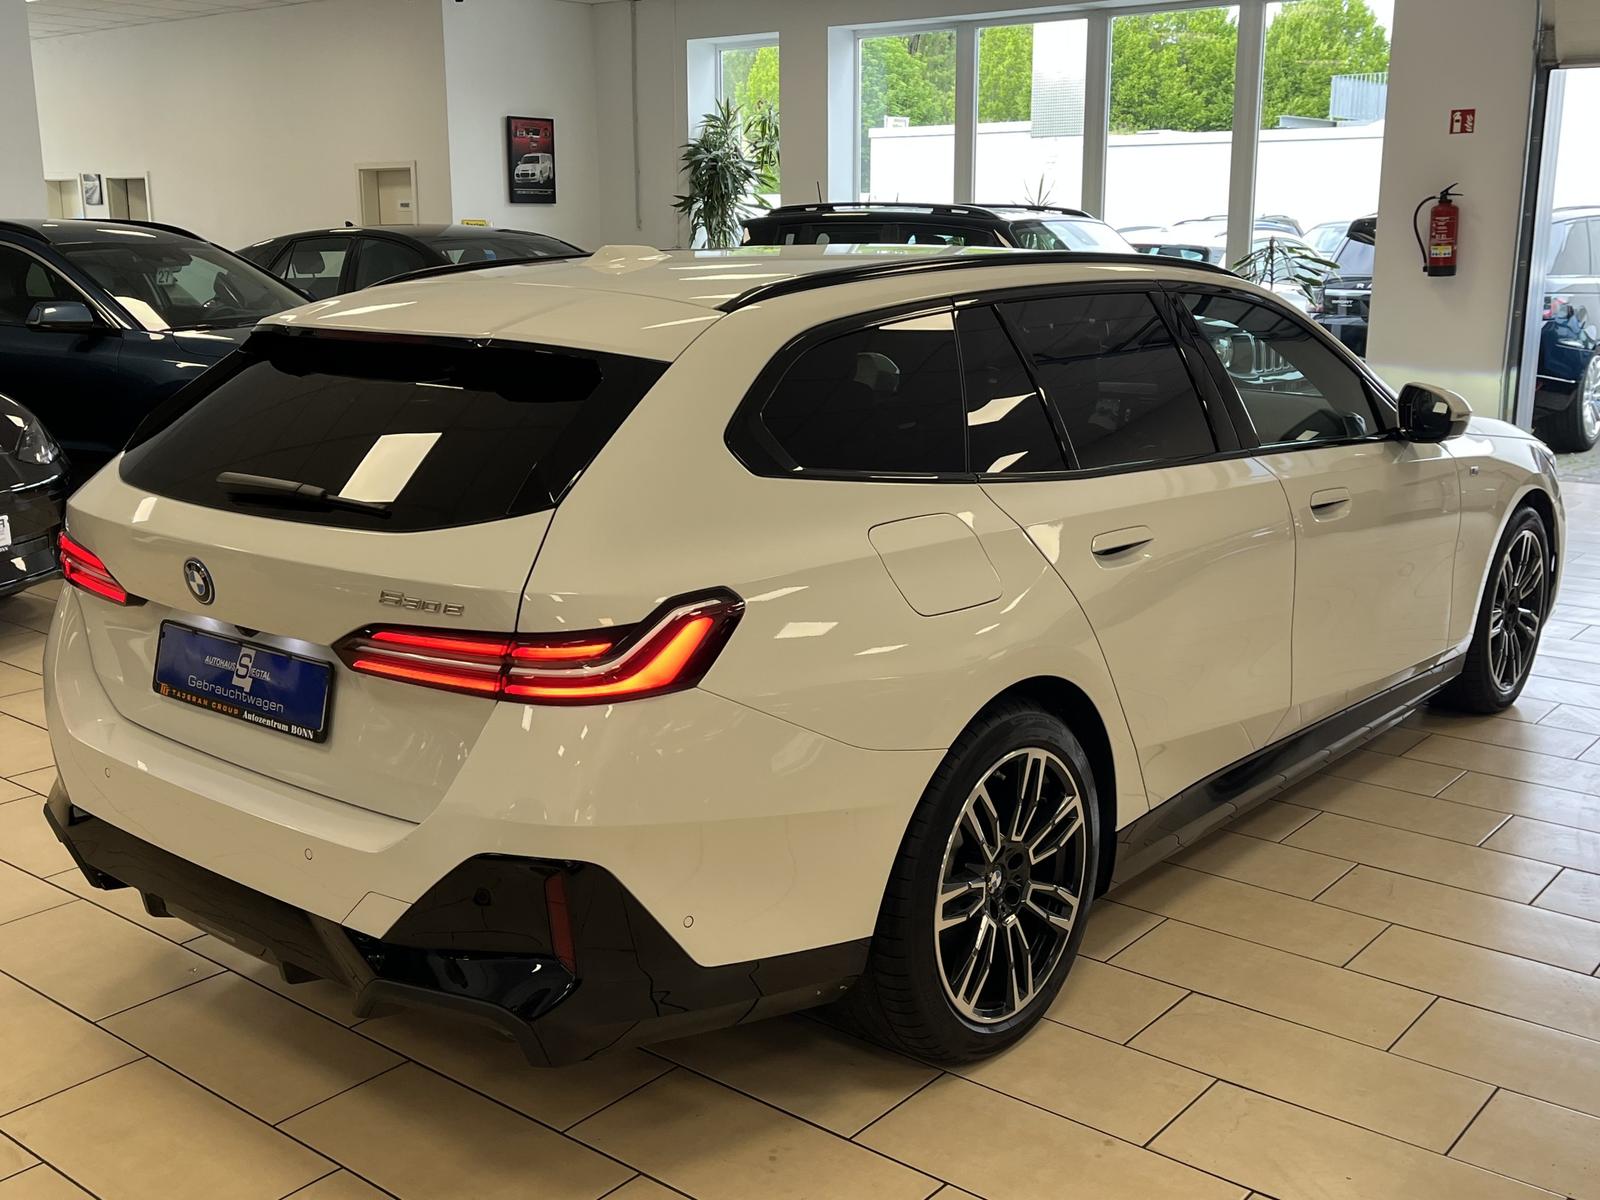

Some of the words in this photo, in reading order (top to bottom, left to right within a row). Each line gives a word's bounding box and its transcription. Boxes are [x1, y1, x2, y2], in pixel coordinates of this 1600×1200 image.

[158, 271, 170, 283] 27
[204, 655, 237, 671] AUTOHAUS
[187, 674, 284, 713] Gebrauchtwagen
[211, 702, 240, 715] GROUP
[242, 710, 289, 732] Autozentrum
[291, 724, 314, 739] BONN
